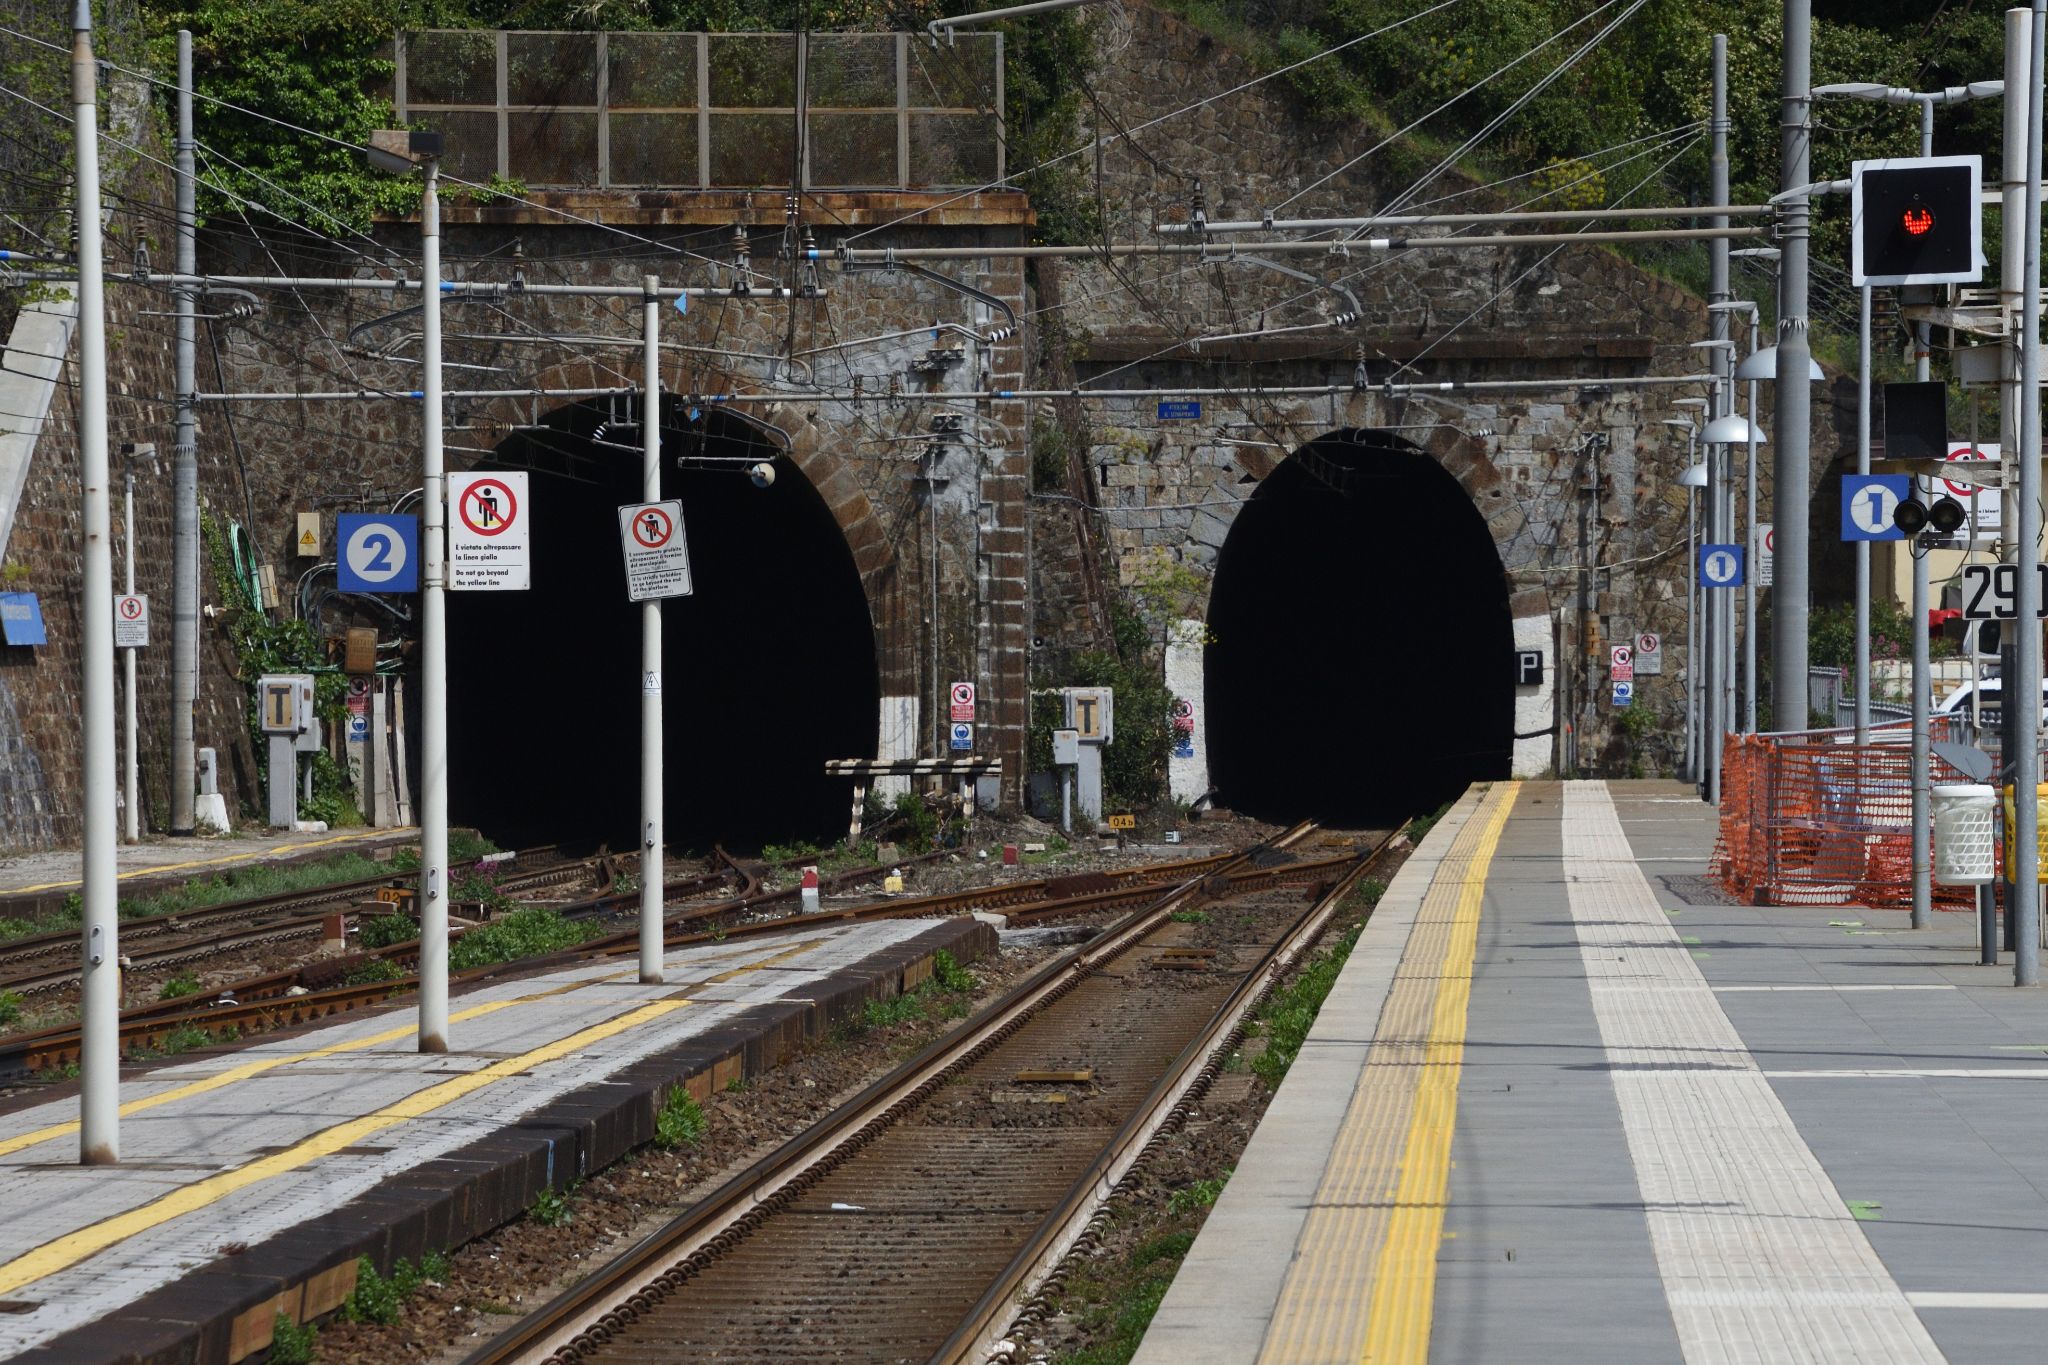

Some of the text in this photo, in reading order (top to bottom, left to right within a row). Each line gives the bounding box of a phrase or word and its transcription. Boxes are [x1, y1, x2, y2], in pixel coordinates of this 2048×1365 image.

[1868, 493, 1882, 524] 1
[363, 534, 392, 571] 2
[1716, 556, 1726, 576] 1
[1521, 654, 1538, 682] P
[270, 688, 290, 724] T
[1078, 700, 1096, 734] T
